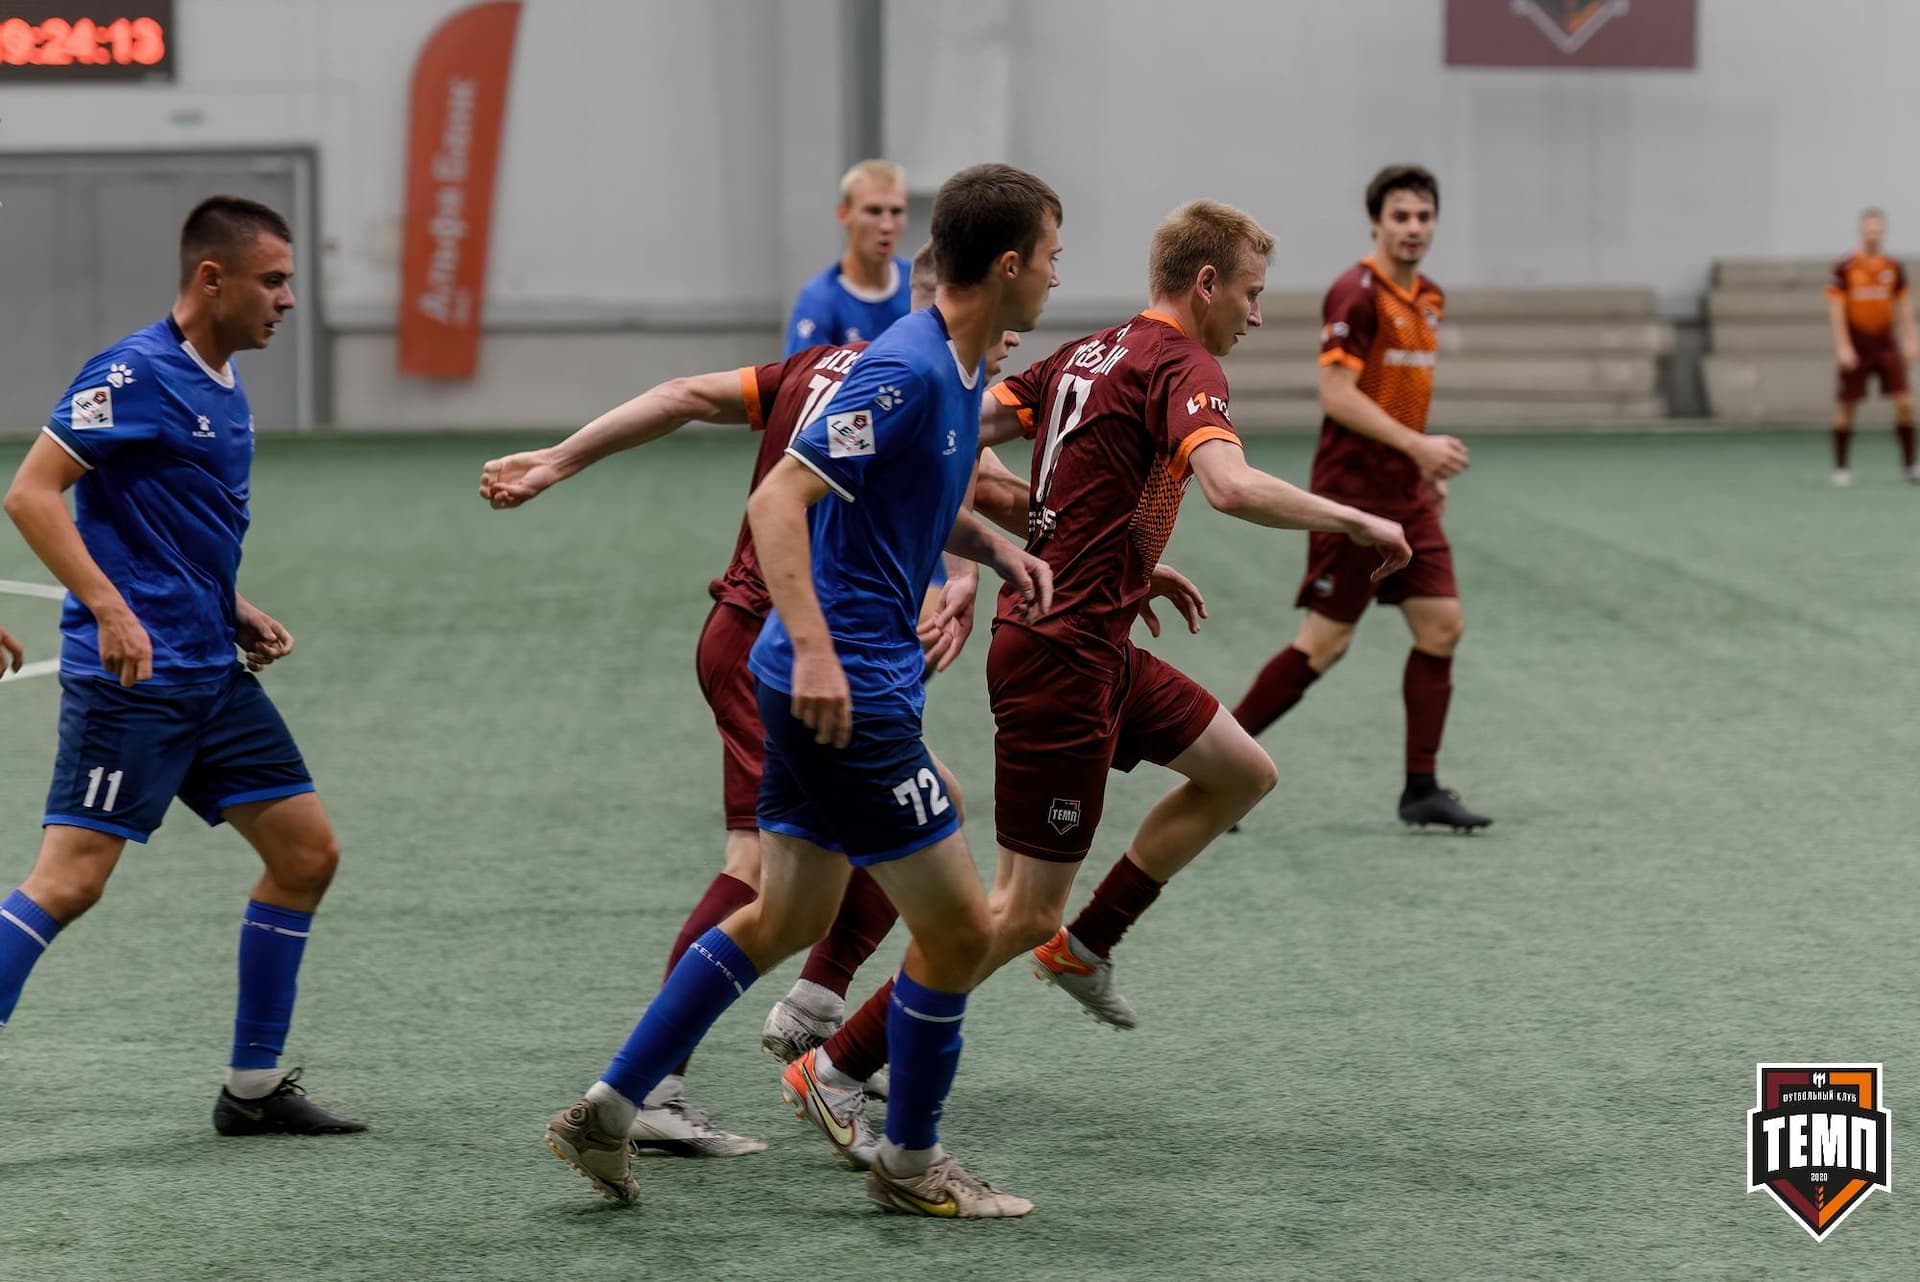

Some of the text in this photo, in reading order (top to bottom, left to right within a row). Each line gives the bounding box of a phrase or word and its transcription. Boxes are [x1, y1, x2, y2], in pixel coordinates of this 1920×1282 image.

[0, 17, 165, 65] 9:24:13
[1035, 372, 1095, 503] 17
[82, 766, 124, 812] 11
[892, 767, 950, 826] 72
[1052, 808, 1078, 823] ТЕМП
